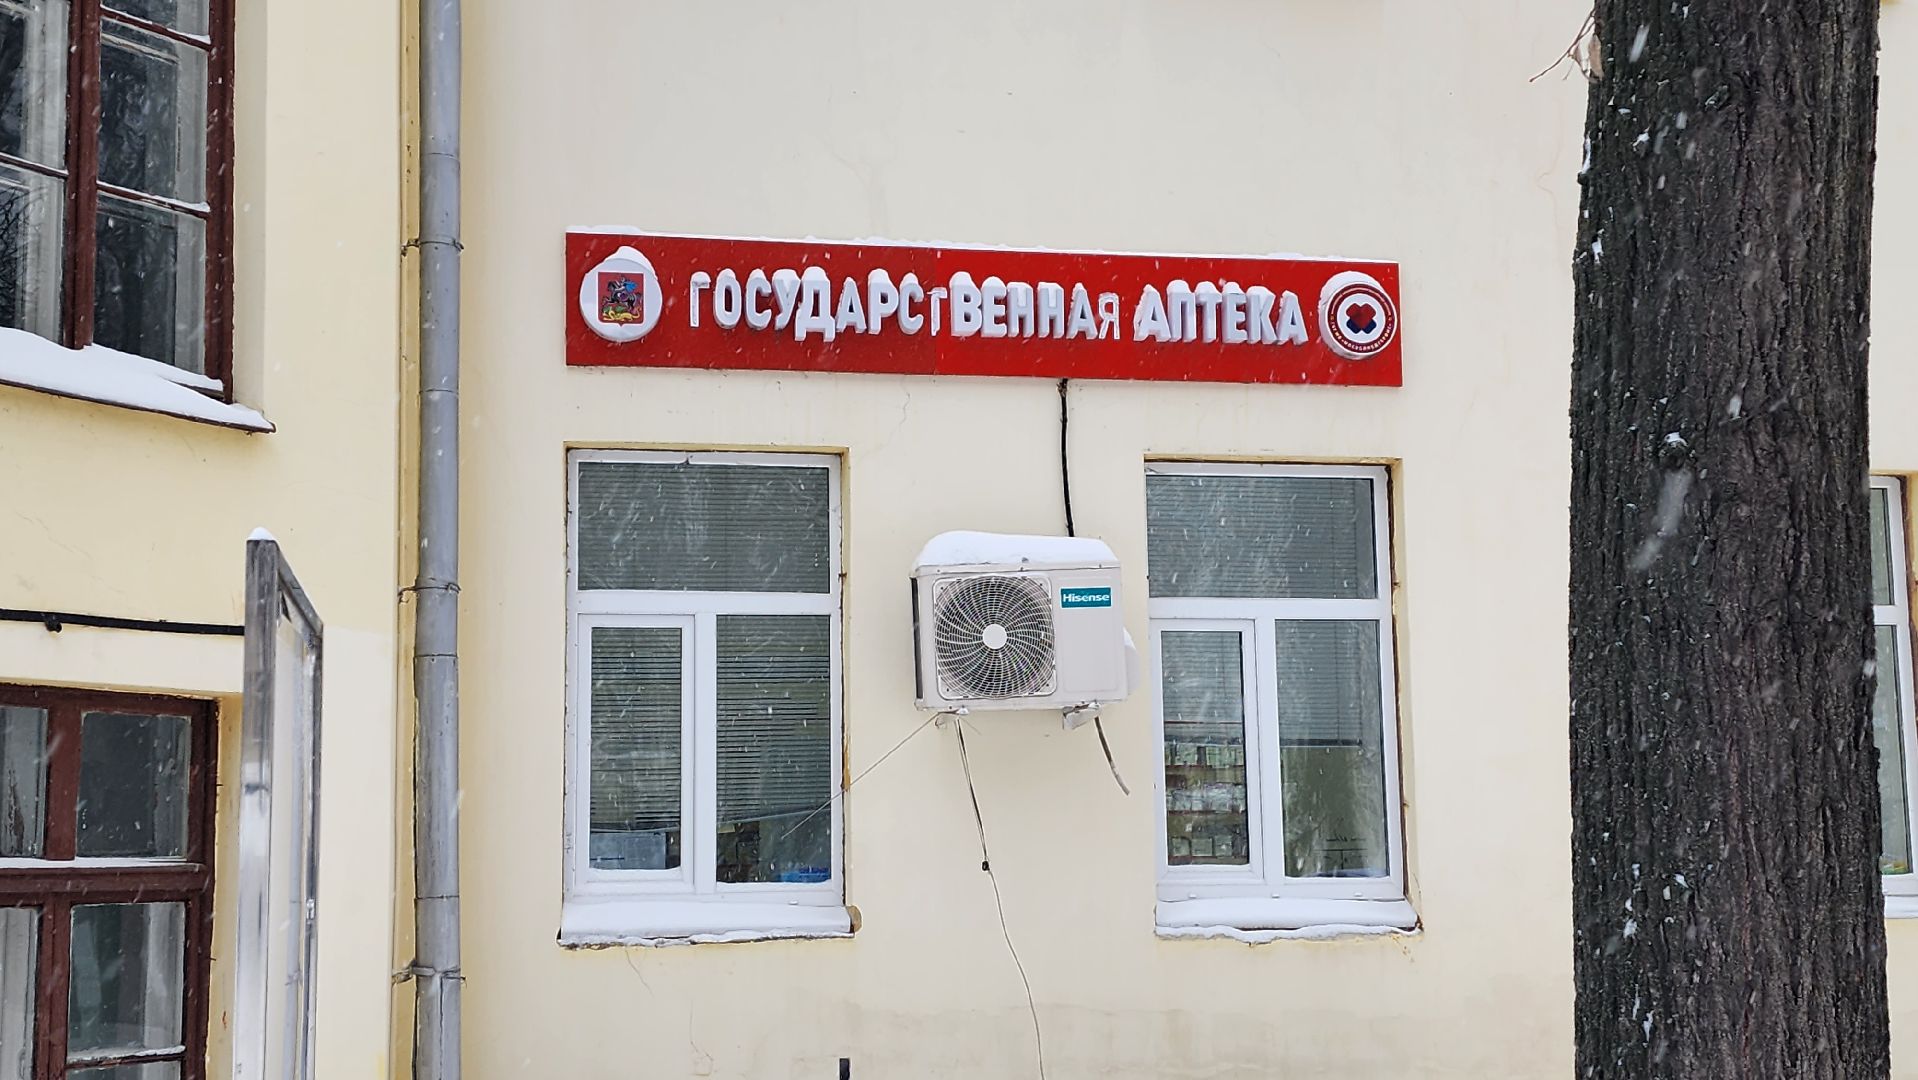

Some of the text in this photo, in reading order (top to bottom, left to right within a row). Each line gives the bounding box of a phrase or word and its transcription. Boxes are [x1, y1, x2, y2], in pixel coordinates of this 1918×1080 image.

[689, 267, 1121, 342] ГОСУДАРСТВЕННАЯ
[1133, 279, 1309, 346] АПТЕКА
[1062, 593, 1110, 603] Hisense
